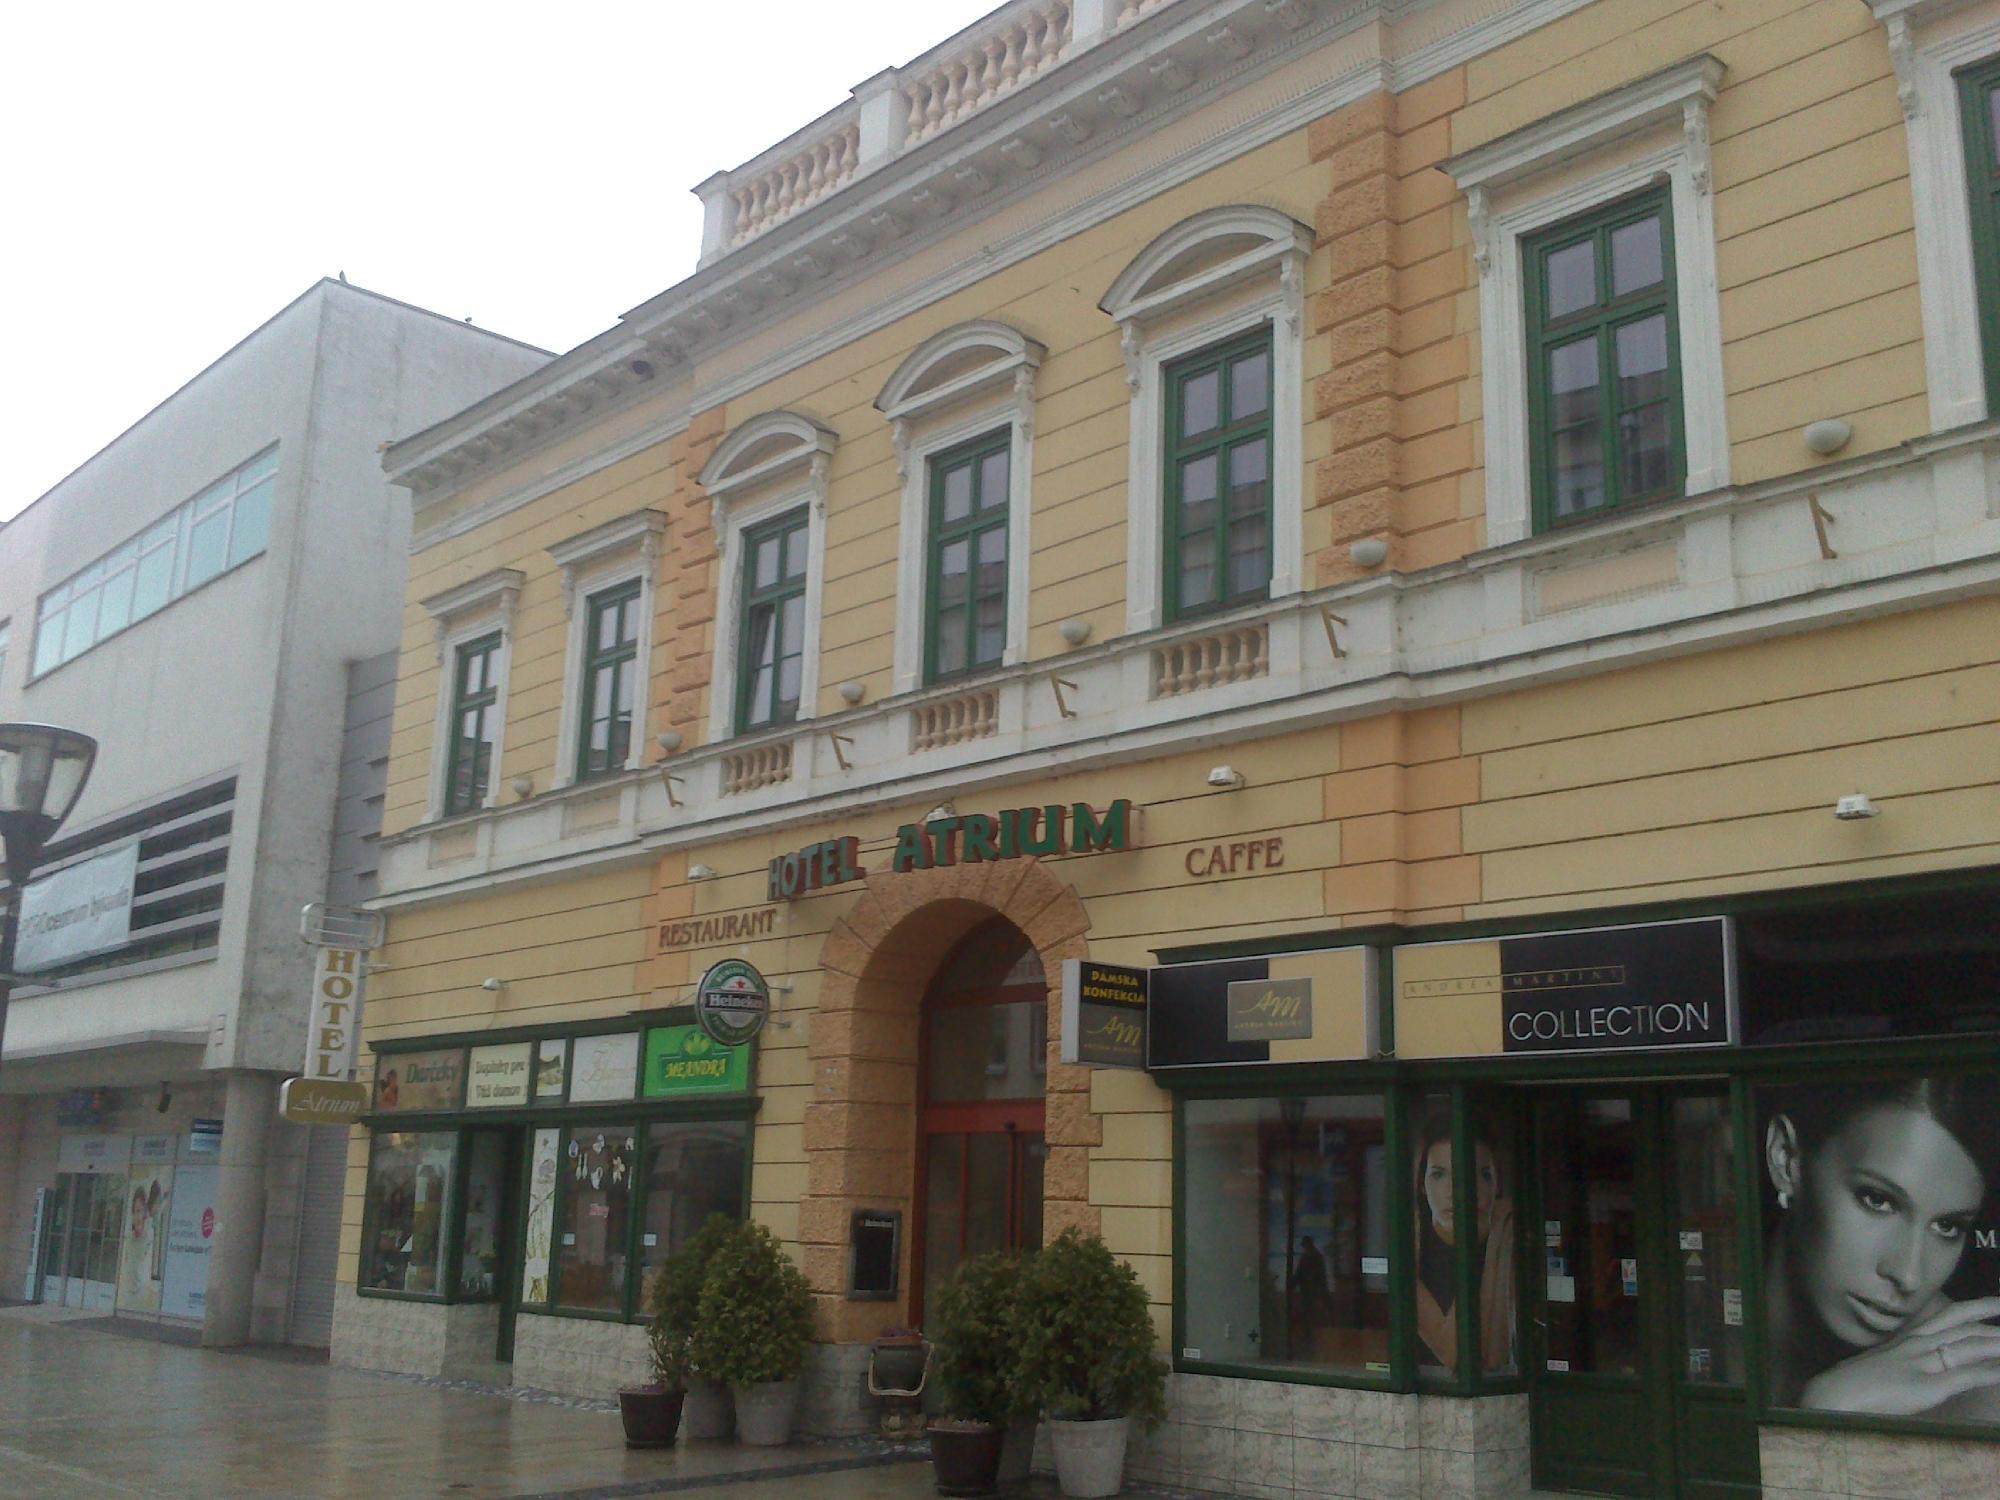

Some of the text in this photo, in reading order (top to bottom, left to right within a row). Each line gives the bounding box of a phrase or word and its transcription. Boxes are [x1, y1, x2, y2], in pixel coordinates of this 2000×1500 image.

[767, 799, 1132, 901] HOTEL ATRIUM
[1185, 837, 1284, 878] CAFFE
[659, 908, 776, 948] RESTAURANT
[317, 949, 355, 1078] HOTEL
[1508, 1000, 1710, 1041] COLLECTION
[665, 1058, 727, 1079] MEANDRA
[292, 1090, 361, 1114] Atrium
